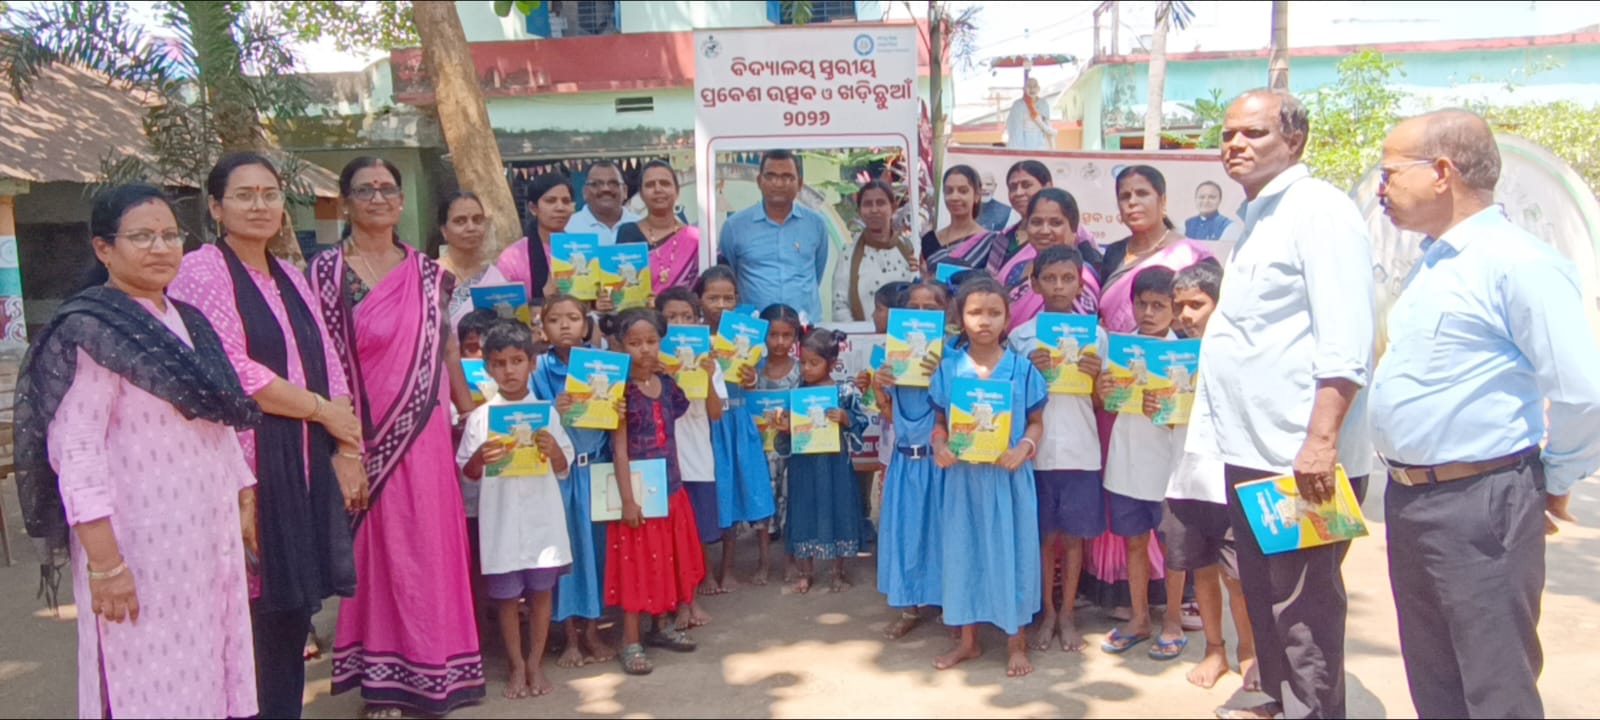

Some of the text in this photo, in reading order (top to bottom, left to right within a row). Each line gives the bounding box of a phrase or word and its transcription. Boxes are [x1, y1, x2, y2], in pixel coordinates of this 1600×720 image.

[730, 57, 816, 79] ବିଦ୍ୟାଳୟ
[700, 86, 762, 107] ପ୍ରବେଶ
[766, 85, 817, 105] ଉତ୍ସବ
[821, 88, 833, 101] ଓ
[783, 110, 831, 127] ୨୦୨୬
